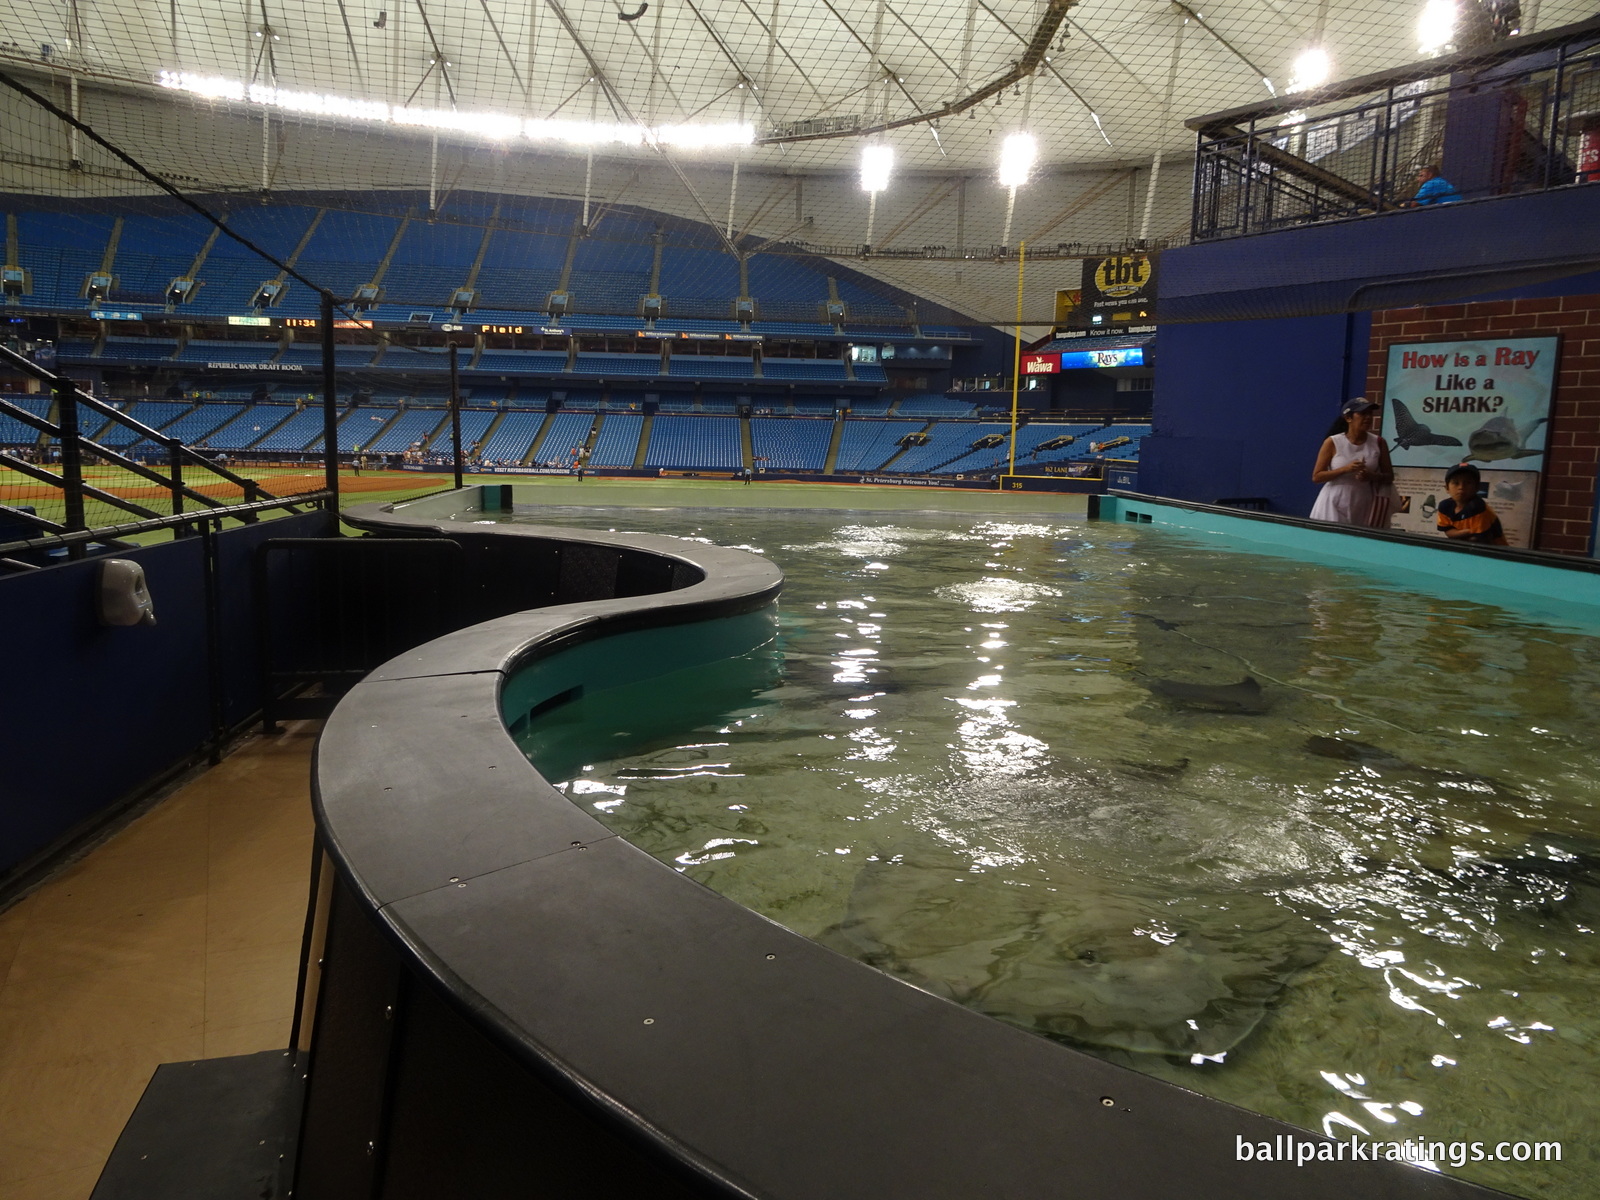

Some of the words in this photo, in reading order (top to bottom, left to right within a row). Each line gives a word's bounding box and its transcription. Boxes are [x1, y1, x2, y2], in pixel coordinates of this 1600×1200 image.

[1103, 257, 1143, 286] tbt
[285, 318, 316, 327] 11:34
[481, 325, 523, 334] Field
[1402, 351, 1448, 369] How
[1454, 353, 1470, 367] is
[1475, 354, 1487, 366] a
[1494, 347, 1540, 369] Ray
[1027, 361, 1053, 373] Wawa
[1435, 374, 1476, 391] Like
[1483, 378, 1495, 390] a
[1422, 396, 1504, 413] SHARK?
[874, 477, 902, 485] Petersburg
